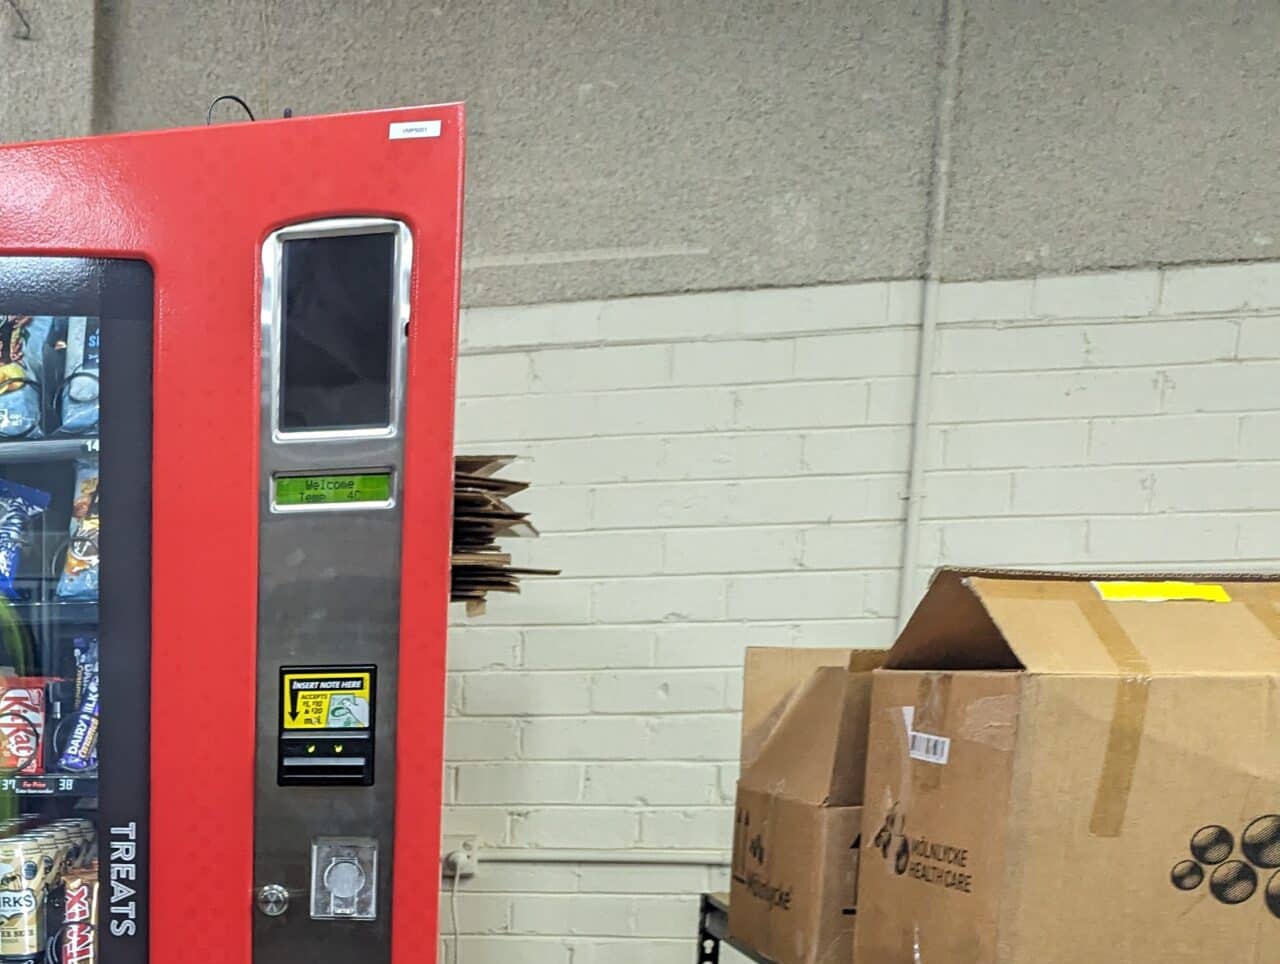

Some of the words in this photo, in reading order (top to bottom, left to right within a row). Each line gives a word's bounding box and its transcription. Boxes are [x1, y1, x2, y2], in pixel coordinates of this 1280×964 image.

[86, 440, 100, 451] 14
[305, 479, 355, 490] Welcome
[292, 681, 319, 690] INSERT
[319, 680, 341, 689] NOTE
[340, 680, 362, 688] HERE
[67, 719, 88, 755] DAIRY
[1, 779, 16, 790] 37
[59, 780, 73, 791] 38
[109, 822, 137, 938] TREATS
[909, 861, 944, 883] HEALTH
[944, 868, 973, 894] CARE
